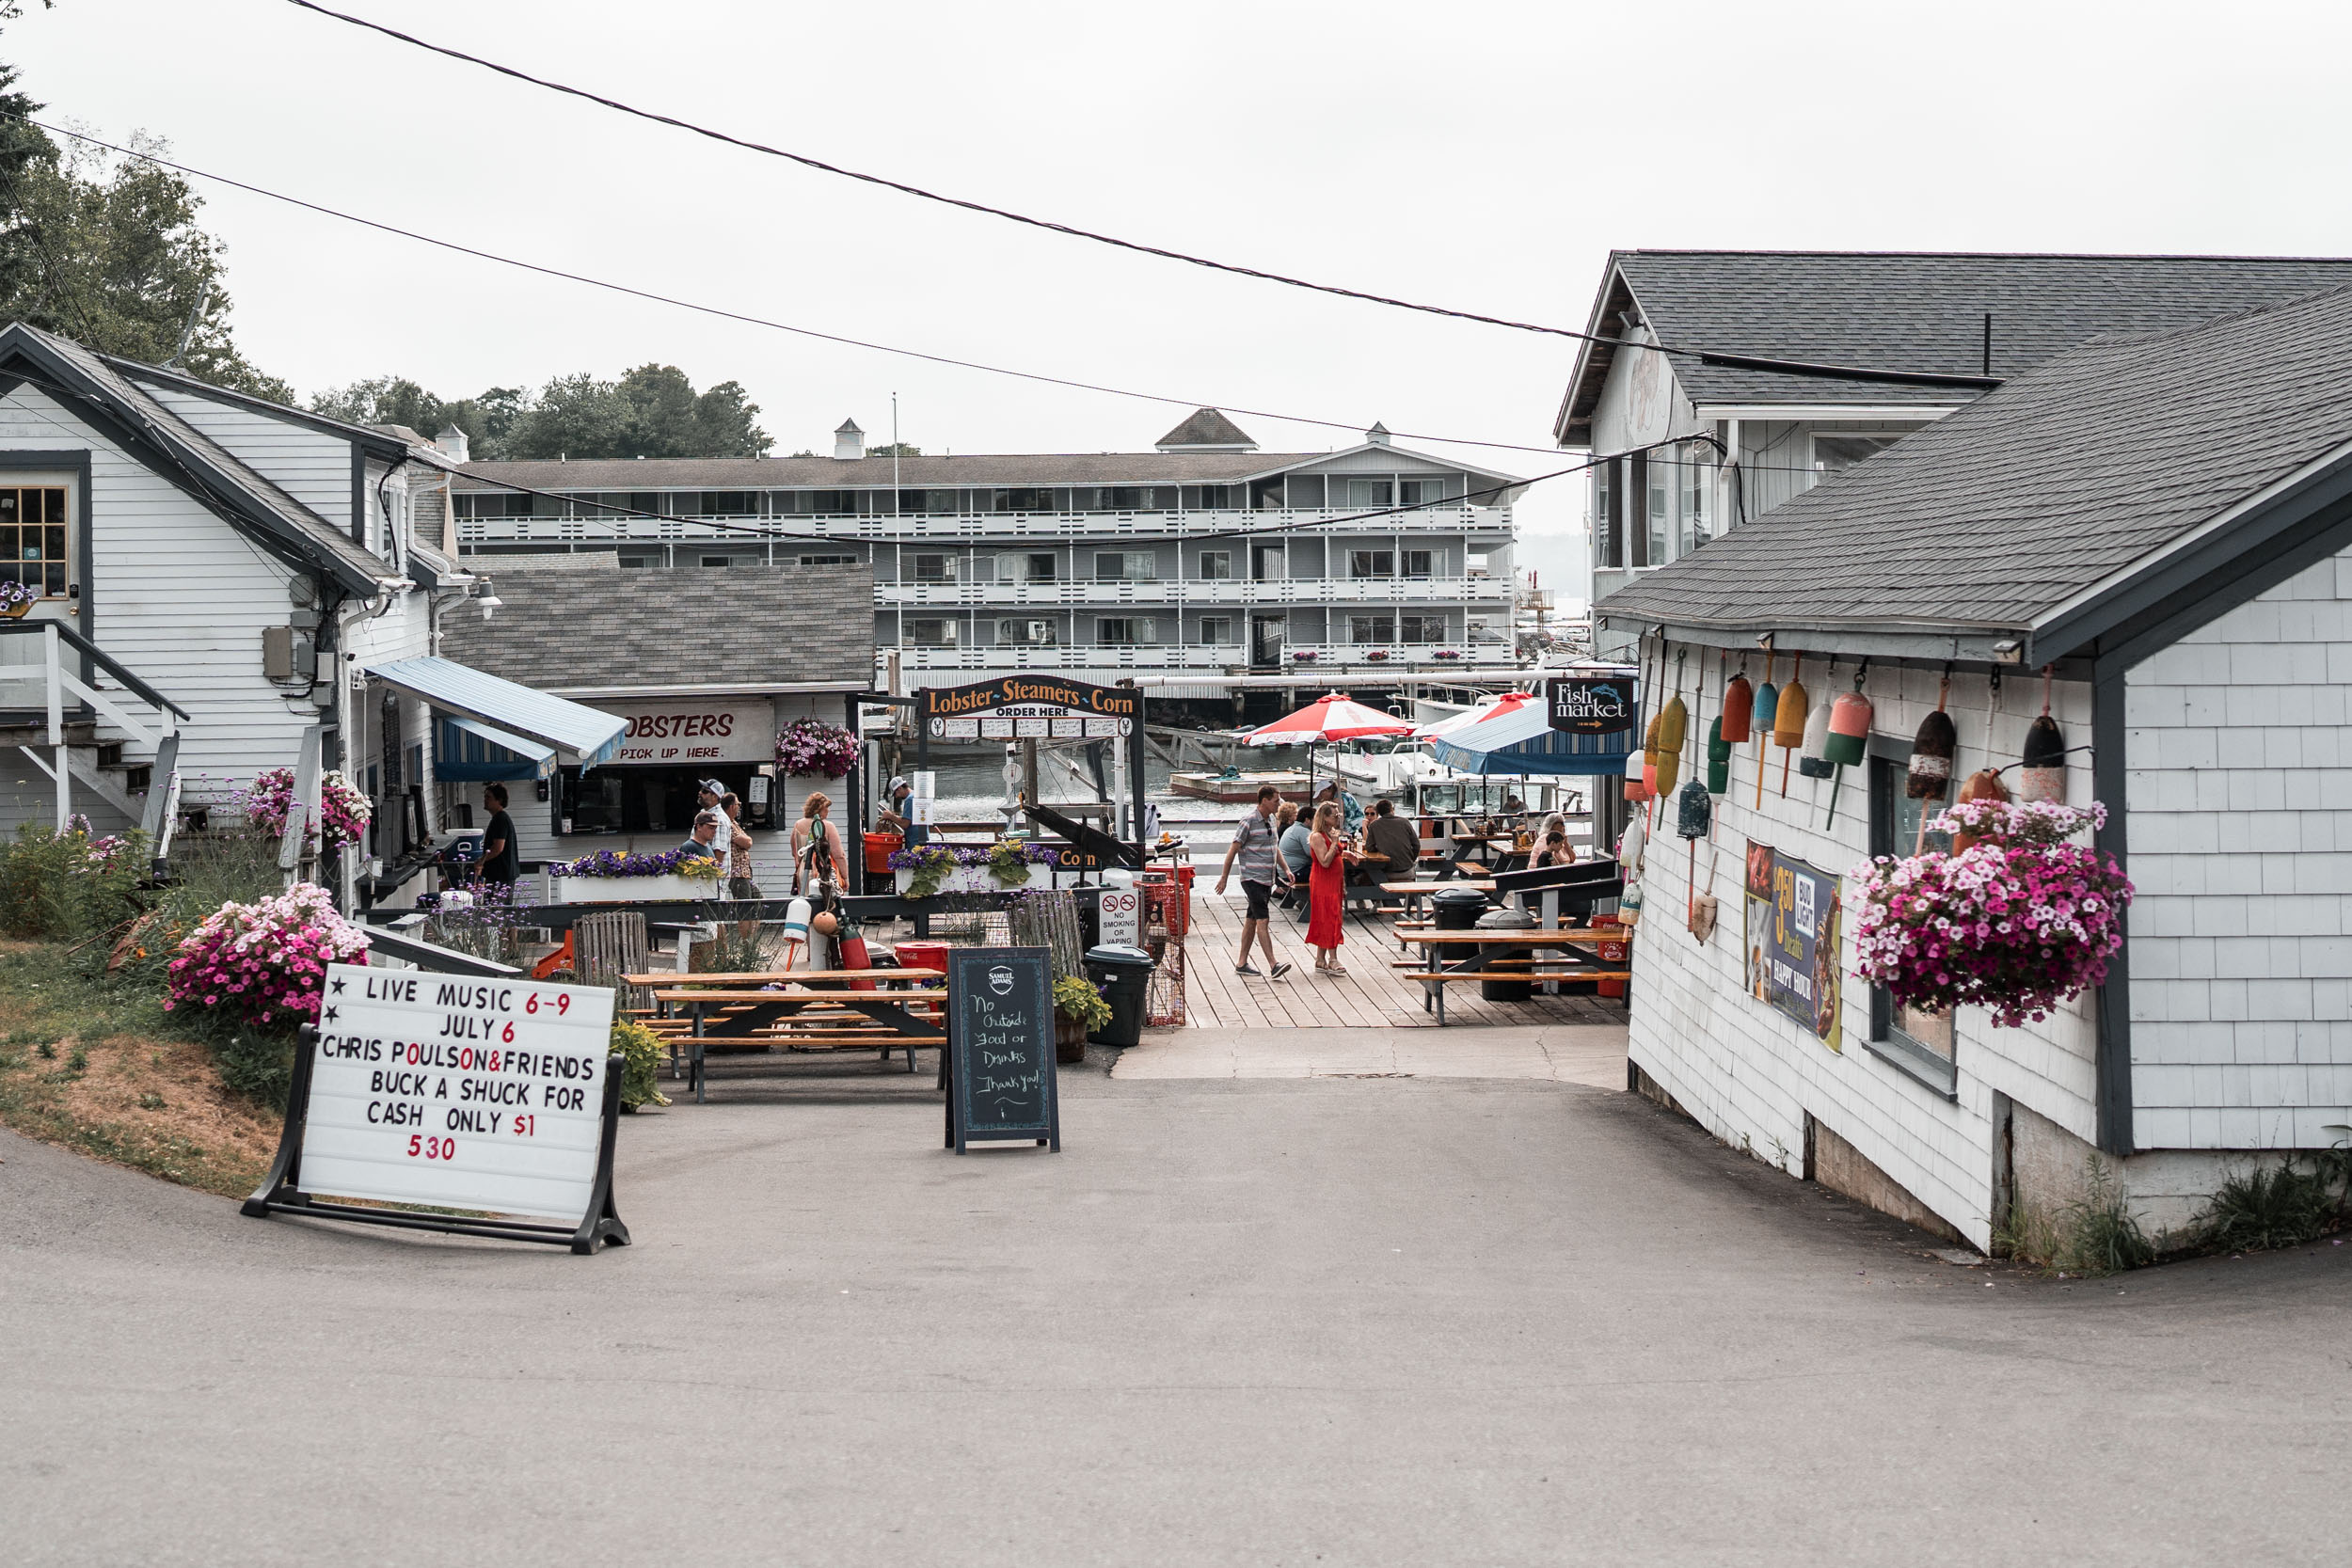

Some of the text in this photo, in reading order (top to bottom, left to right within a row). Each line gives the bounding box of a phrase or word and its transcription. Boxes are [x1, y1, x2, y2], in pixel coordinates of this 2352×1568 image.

[930, 679, 1134, 713] Lobster Steamers Corn
[1556, 683, 1592, 704] Fish
[995, 707, 1069, 717] ORDER HERE
[1556, 697, 1628, 717] market
[625, 713, 734, 738] OBSTERS
[619, 747, 724, 759] PICK UP HERE.
[1060, 849, 1096, 865] Con
[1799, 880, 1812, 908] BUD
[1103, 920, 1136, 928] SMOKING
[1797, 907, 1814, 931] LIGHT
[1784, 929, 1804, 961] Drafts
[988, 972, 1015, 980] SAMUEL
[1773, 958, 1812, 1001] HAPPY HOUR
[367, 976, 570, 1016] LIVE MUSIC 6-9
[439, 1014, 515, 1043] JULY 6
[1011, 1035, 1028, 1043] or
[323, 1035, 594, 1081] CHRIS POULSON&FRIENDS
[371, 1070, 584, 1111] BUCK A SHUCK FOR
[976, 1076, 1020, 1094] Thank
[367, 1101, 534, 1137] CASH ONLY $1
[407, 1134, 455, 1161] 530
